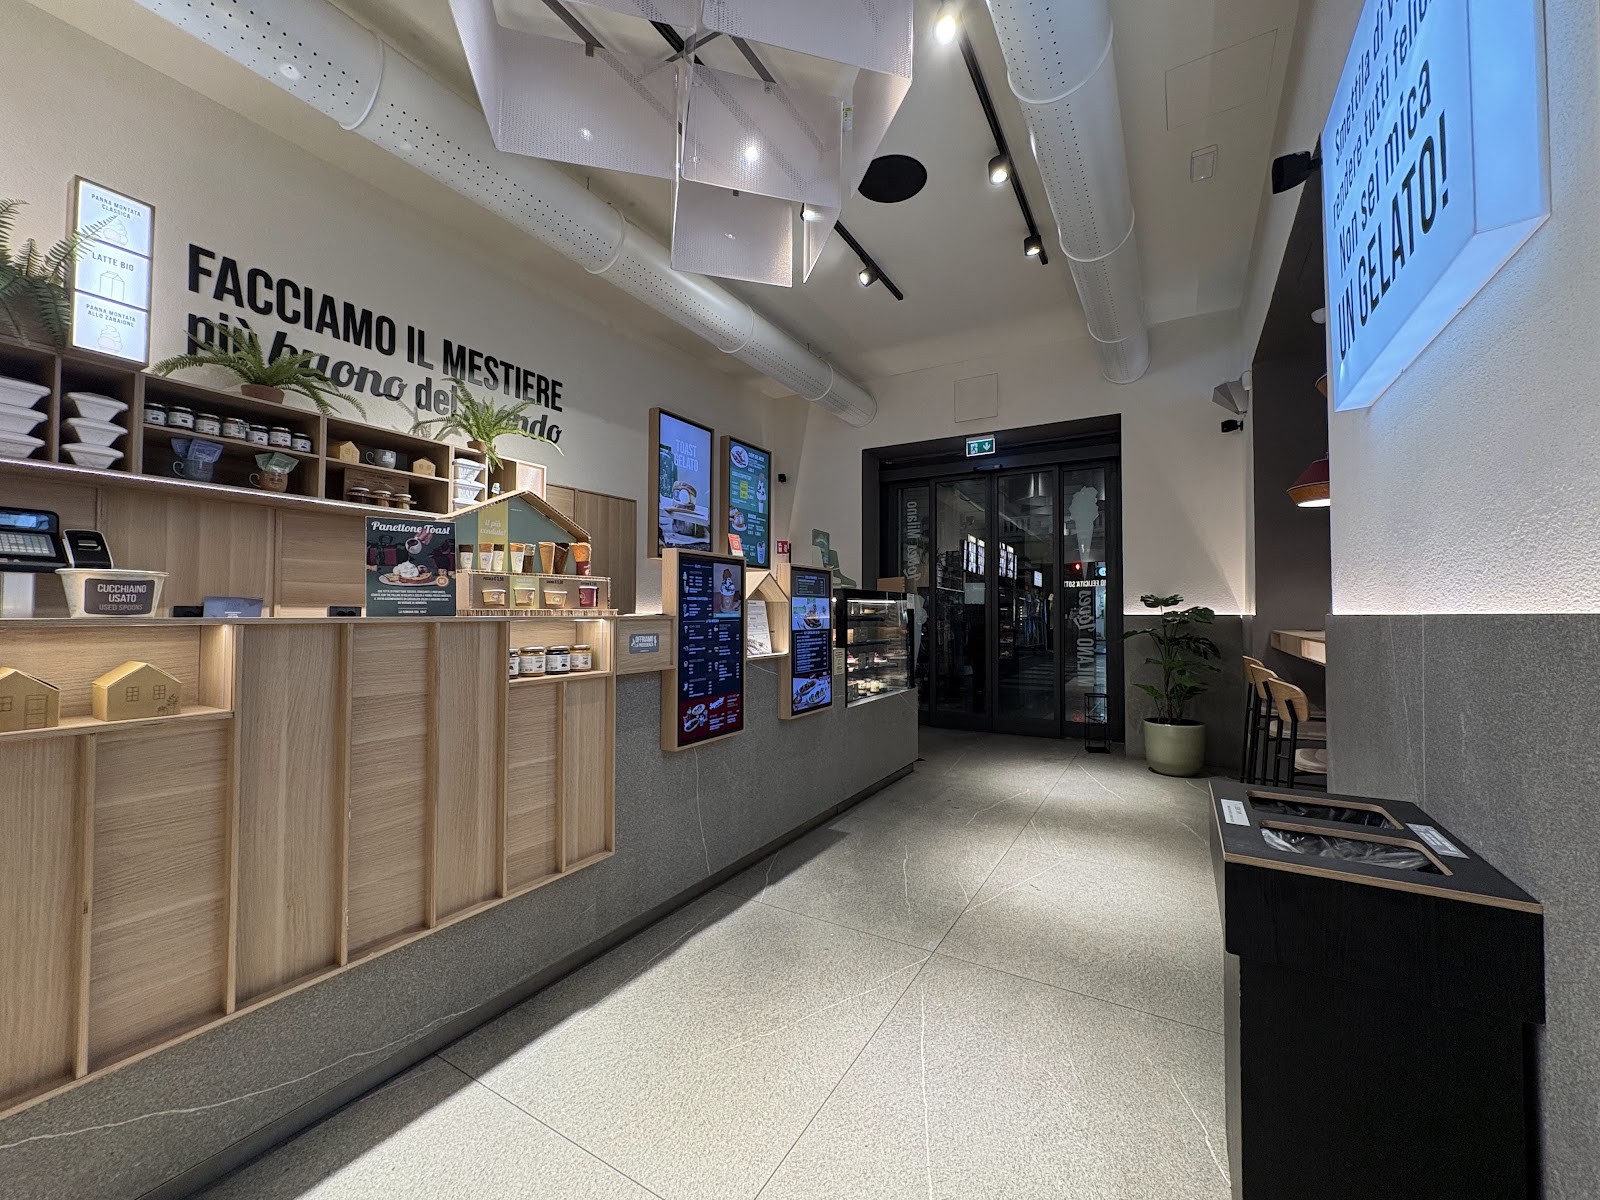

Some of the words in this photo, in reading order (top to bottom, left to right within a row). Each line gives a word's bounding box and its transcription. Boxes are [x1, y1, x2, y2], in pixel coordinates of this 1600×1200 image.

[1334, 50, 1371, 166] Smettila
[1333, 135, 1363, 229] rendere
[1363, 53, 1390, 149] tutti
[1338, 211, 1359, 279] Non
[1360, 147, 1380, 232] sei
[1384, 59, 1432, 185] mica
[91, 193, 112, 208] PANNA
[113, 201, 141, 217] MONTATA
[101, 203, 131, 219] CLASSICA
[1337, 285, 1355, 361] UN
[1358, 109, 1449, 328] GELATO!
[92, 252, 118, 267] LATTE
[120, 261, 134, 272] BIO
[86, 303, 107, 315] PANNA
[108, 309, 136, 323] MONTATA
[87, 310, 104, 319] ALLO
[105, 314, 135, 328] ZABAIONE
[188, 243, 396, 356] FACCIAMO
[407, 325, 434, 371] IL
[443, 338, 563, 413] MESTIERE
[415, 377, 458, 418] del
[463, 401, 563, 444] ndo
[676, 439, 697, 458] TOAST
[673, 453, 699, 472] GELATO
[371, 520, 423, 534] Panettone
[423, 525, 451, 535] Toast
[98, 584, 147, 593] CUCCHIAINO
[108, 594, 137, 603] USATO
